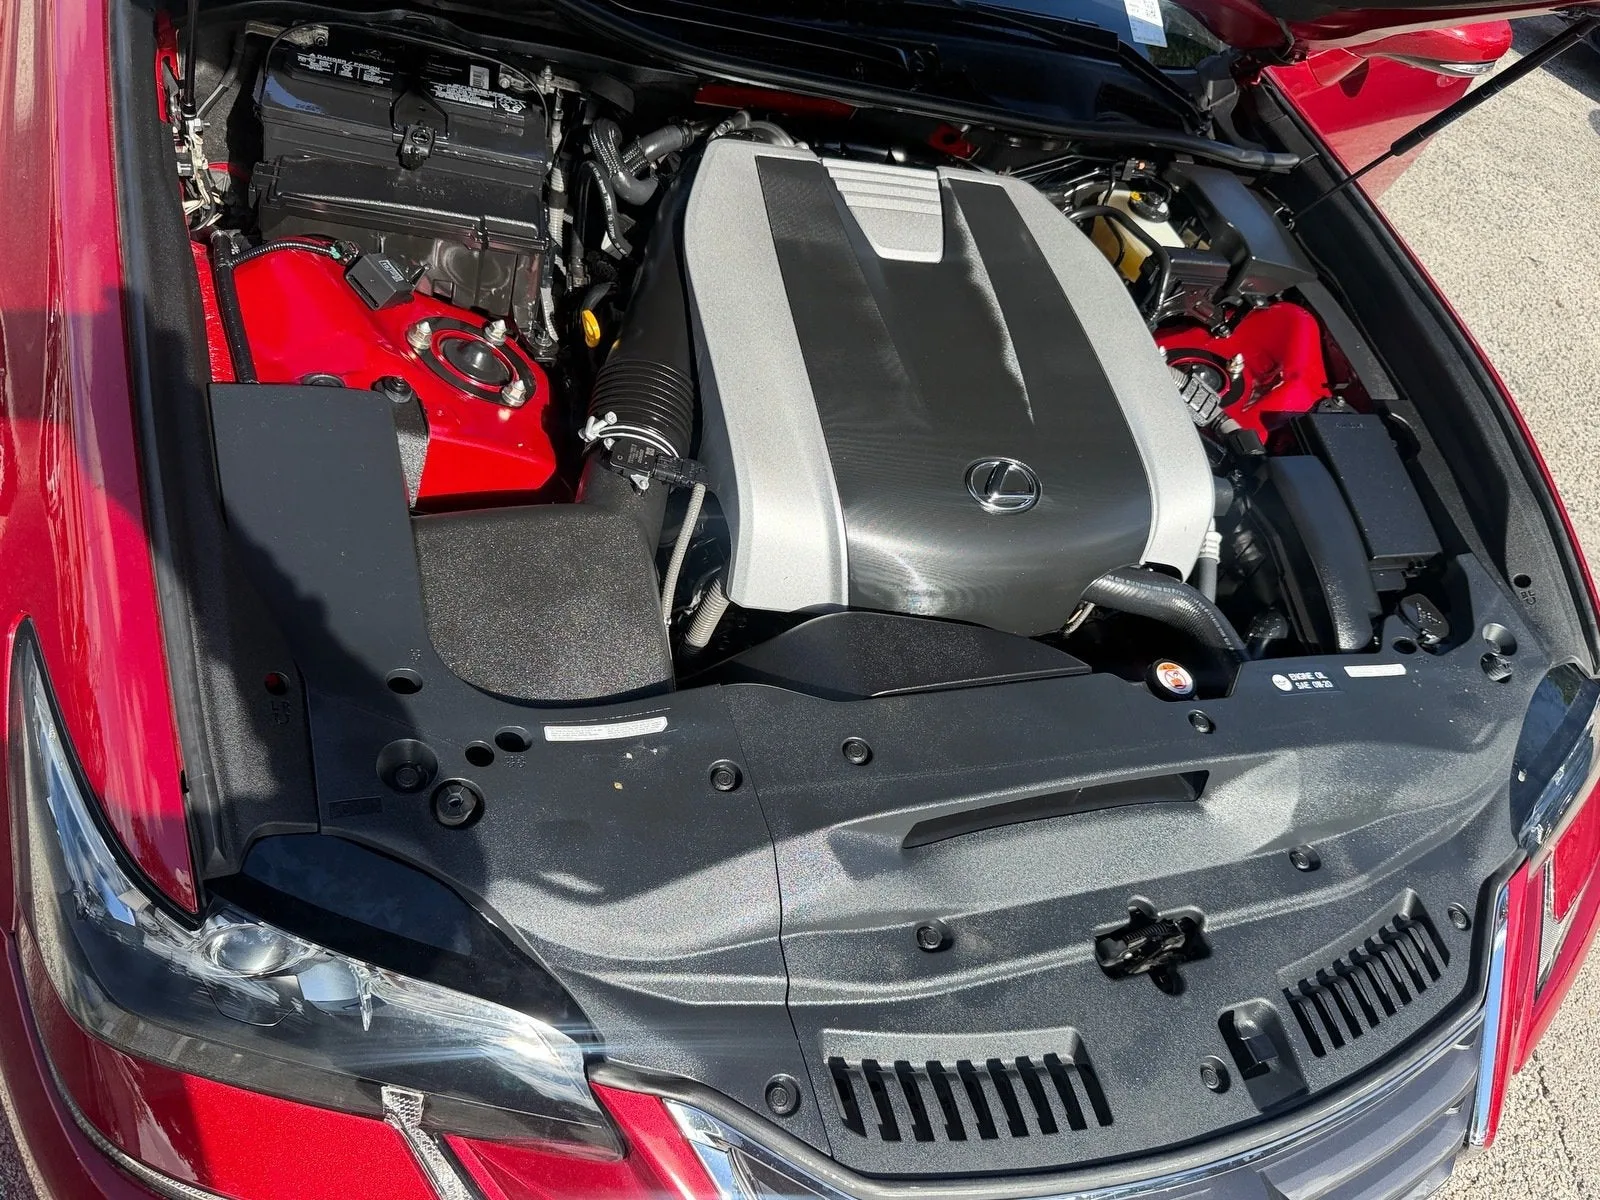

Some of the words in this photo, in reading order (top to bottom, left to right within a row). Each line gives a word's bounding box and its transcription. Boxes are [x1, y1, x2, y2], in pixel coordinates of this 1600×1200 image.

[317, 54, 347, 64] DANGER
[353, 62, 381, 71] POISON
[1288, 672, 1315, 681] ENGINE
[1315, 671, 1329, 680] OIL
[1295, 681, 1312, 690] SAE
